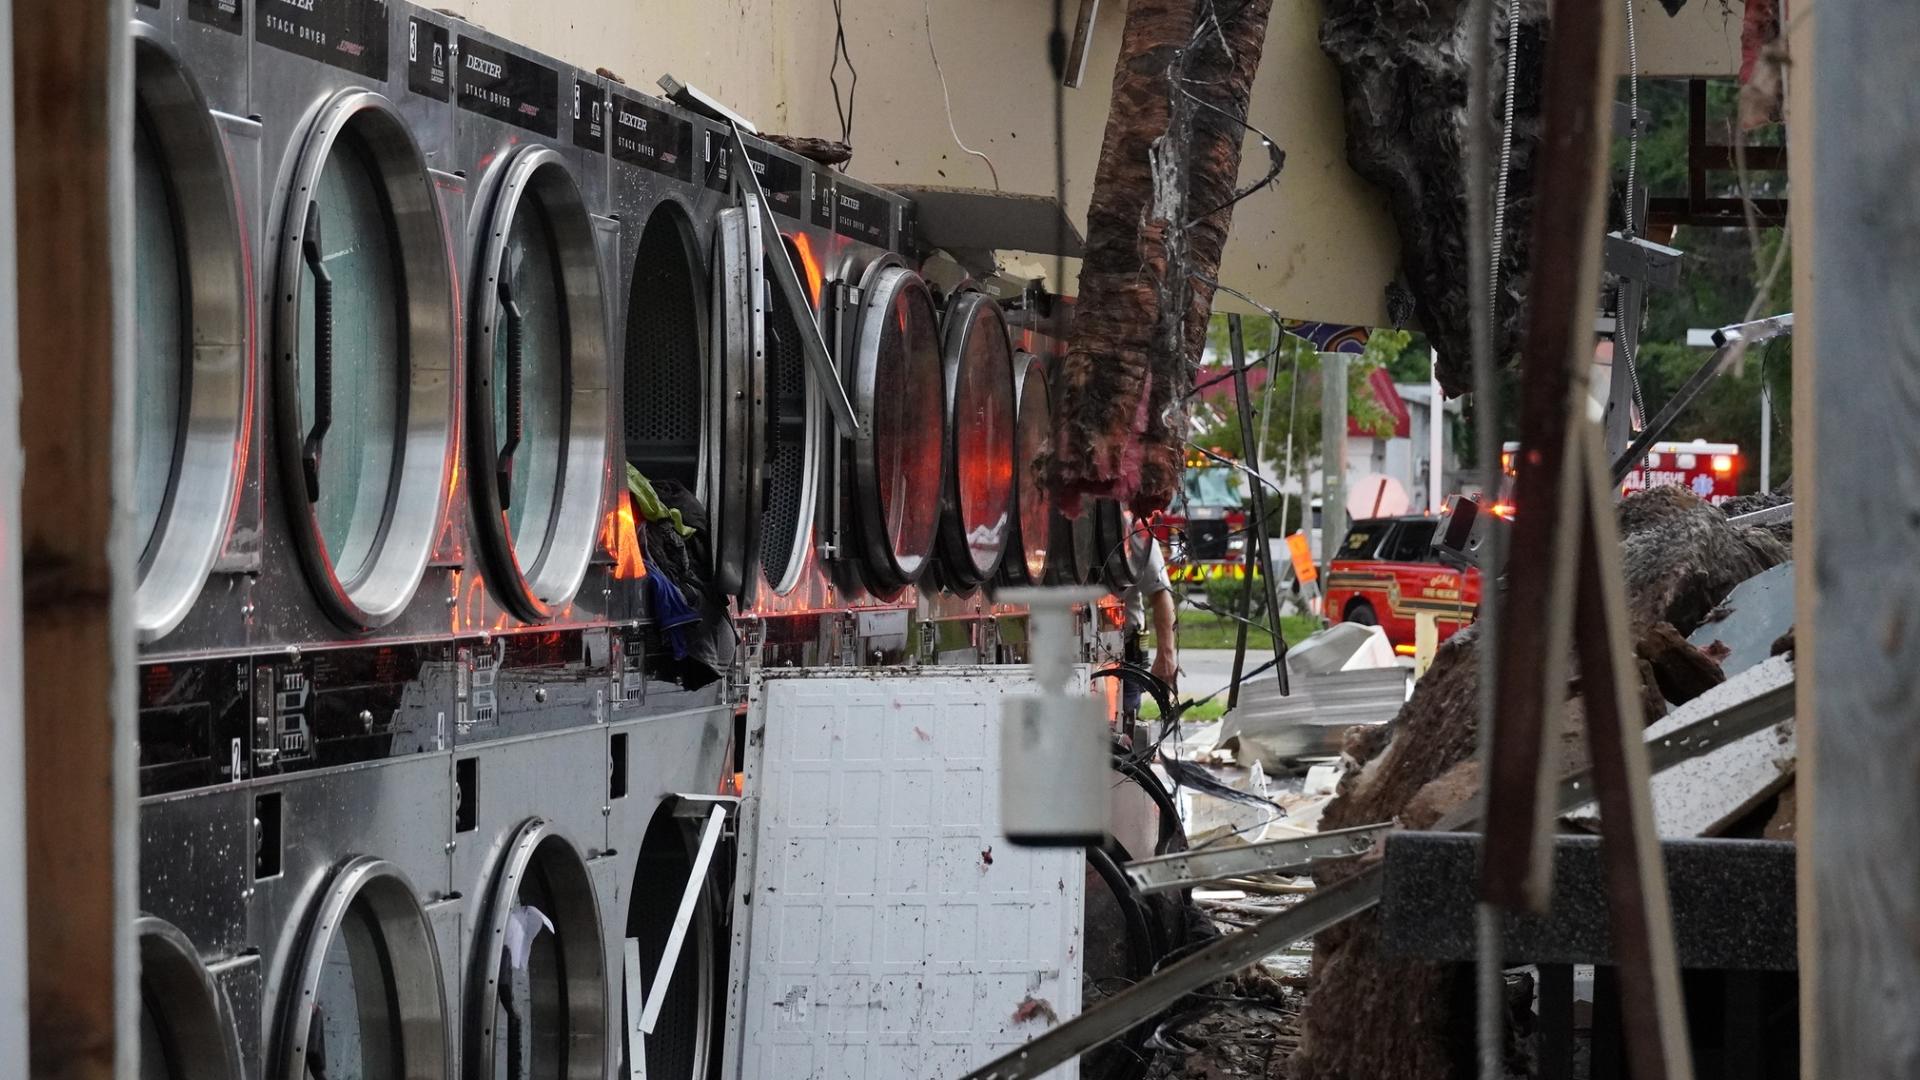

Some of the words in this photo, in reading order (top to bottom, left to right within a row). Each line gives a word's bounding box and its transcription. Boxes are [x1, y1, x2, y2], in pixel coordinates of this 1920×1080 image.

[266, 14, 294, 35] STACK
[300, 25, 326, 45] DRYER
[466, 54, 502, 79] DEXTER
[465, 83, 487, 100] STACK
[490, 92, 510, 108] DRYER
[618, 111, 647, 132] DEXTER
[839, 195, 860, 211] DEXTER
